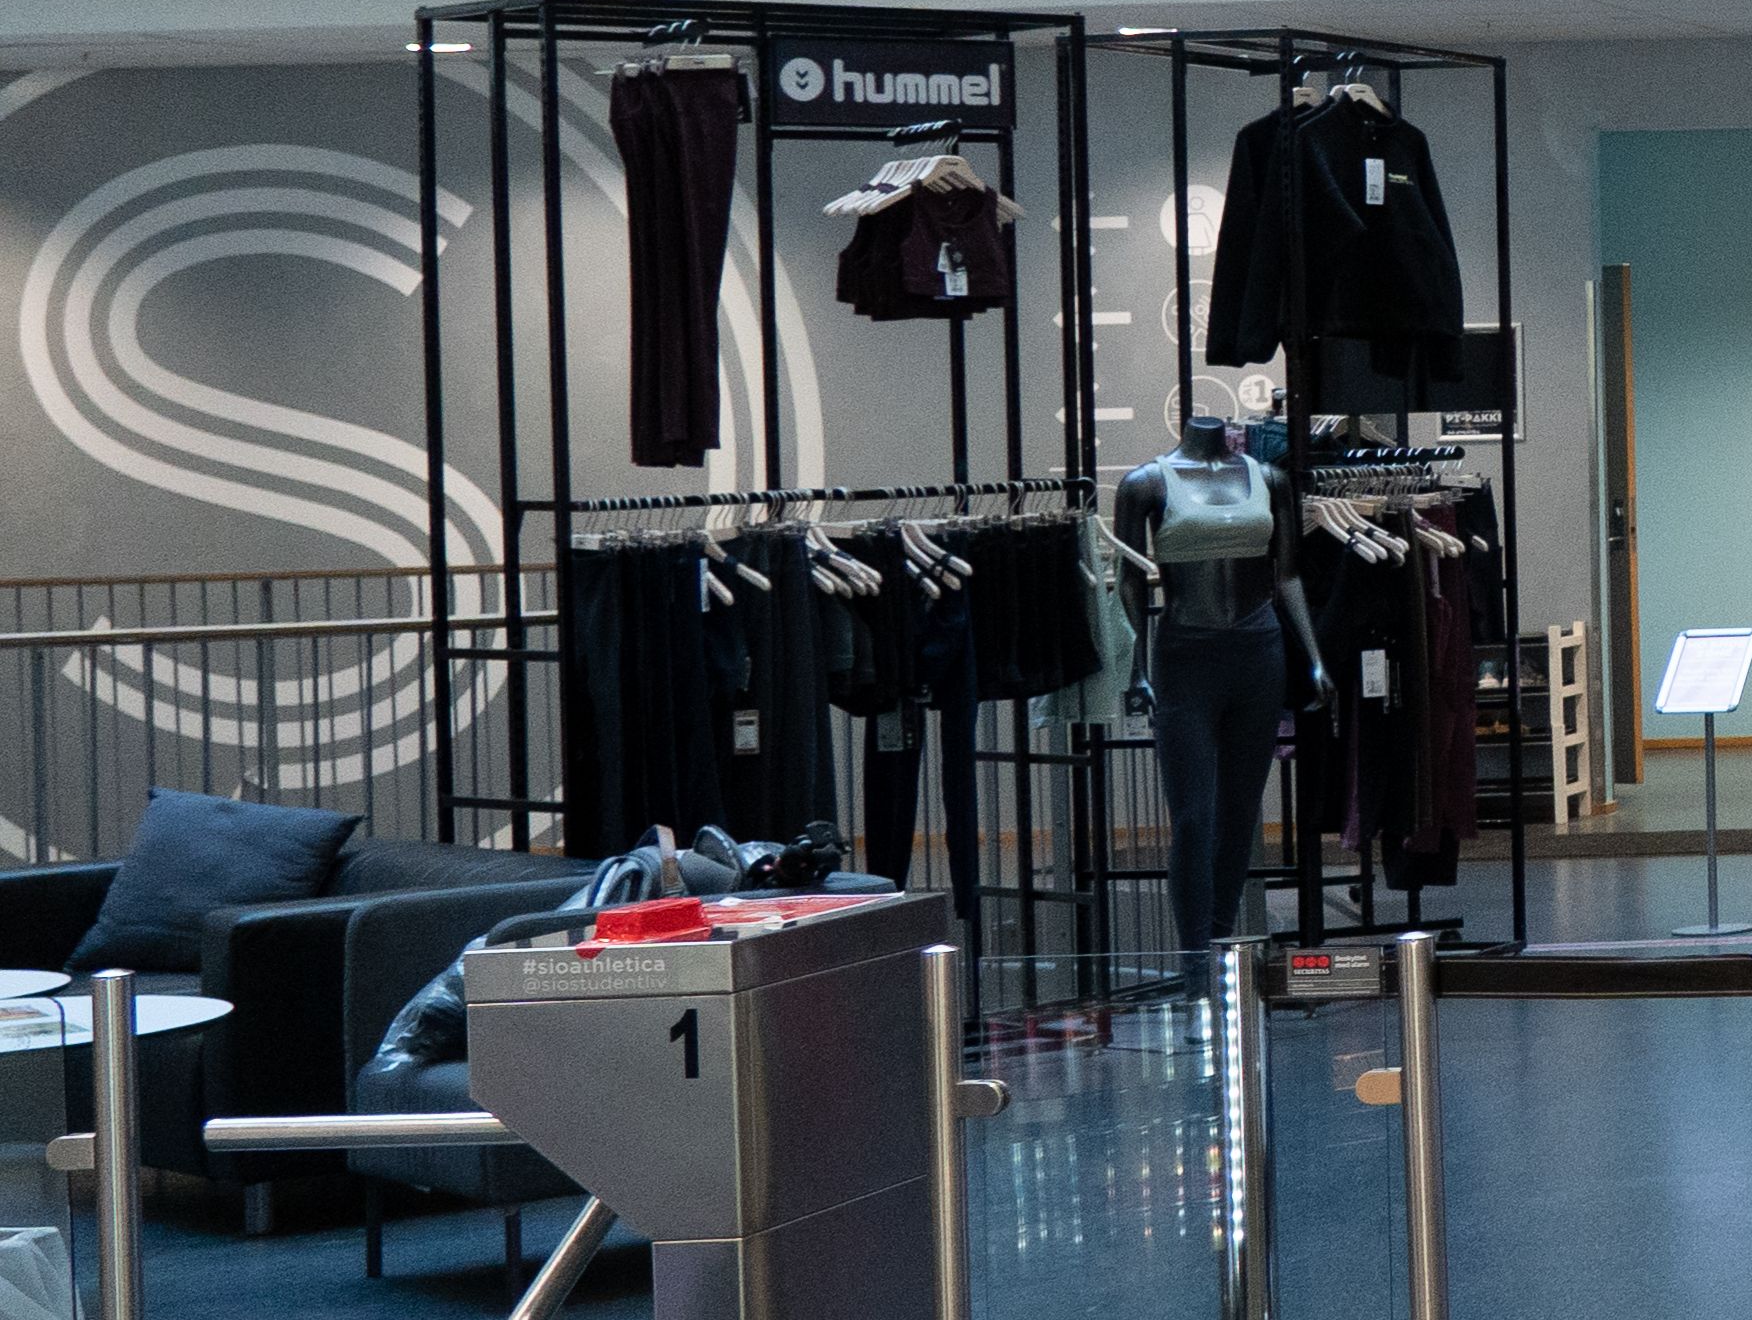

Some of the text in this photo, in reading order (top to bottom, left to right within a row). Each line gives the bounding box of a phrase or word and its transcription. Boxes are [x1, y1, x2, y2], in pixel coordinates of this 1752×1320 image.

[833, 58, 1001, 106] hummel
[1254, 379, 1269, 403] 1
[523, 957, 666, 975] #sioathletica
[523, 976, 667, 995] @siostudentliv
[669, 1008, 702, 1079] 1
